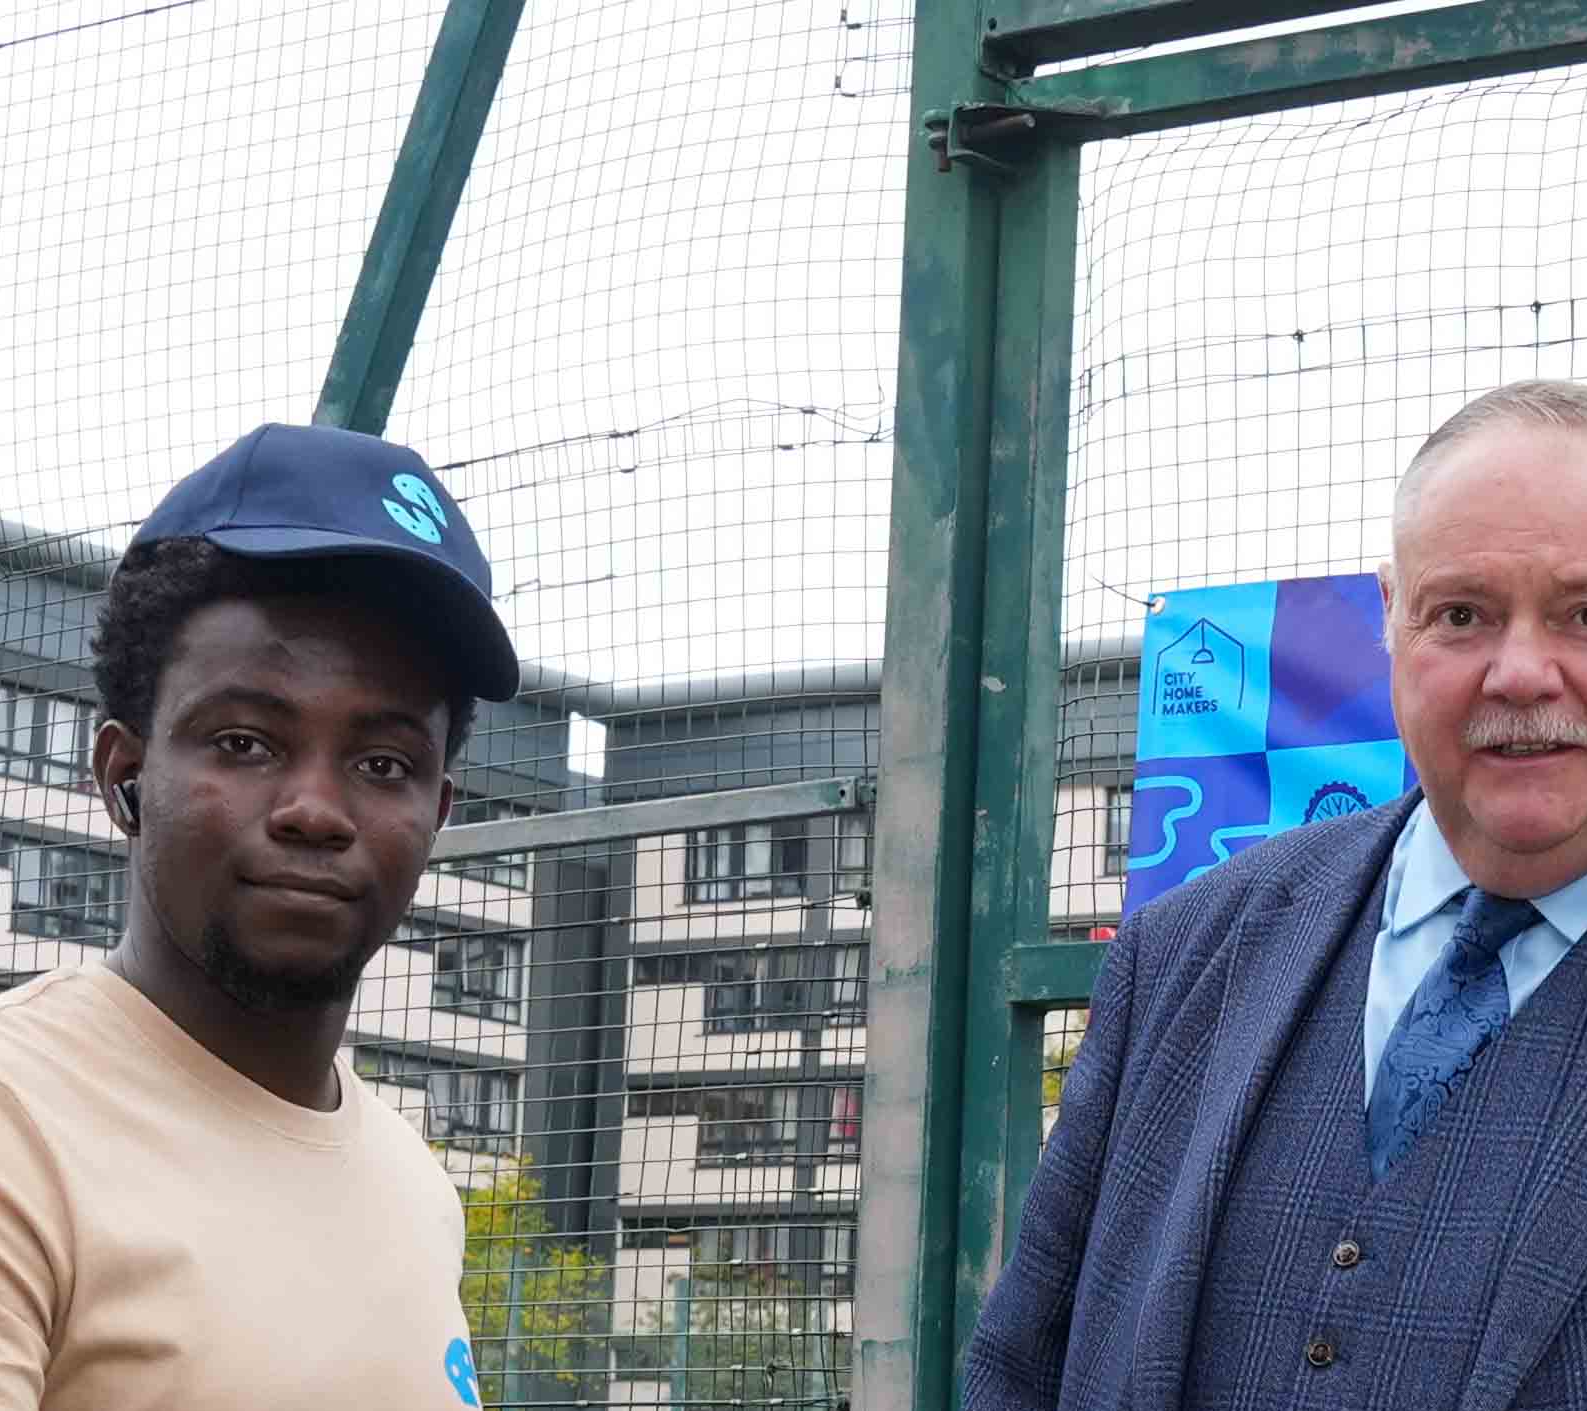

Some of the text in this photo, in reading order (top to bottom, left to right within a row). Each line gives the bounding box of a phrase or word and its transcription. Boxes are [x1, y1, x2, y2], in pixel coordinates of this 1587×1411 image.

[1163, 671, 1197, 686] CITY
[1163, 686, 1203, 700] HOME
[1162, 700, 1219, 716] MAKERS
